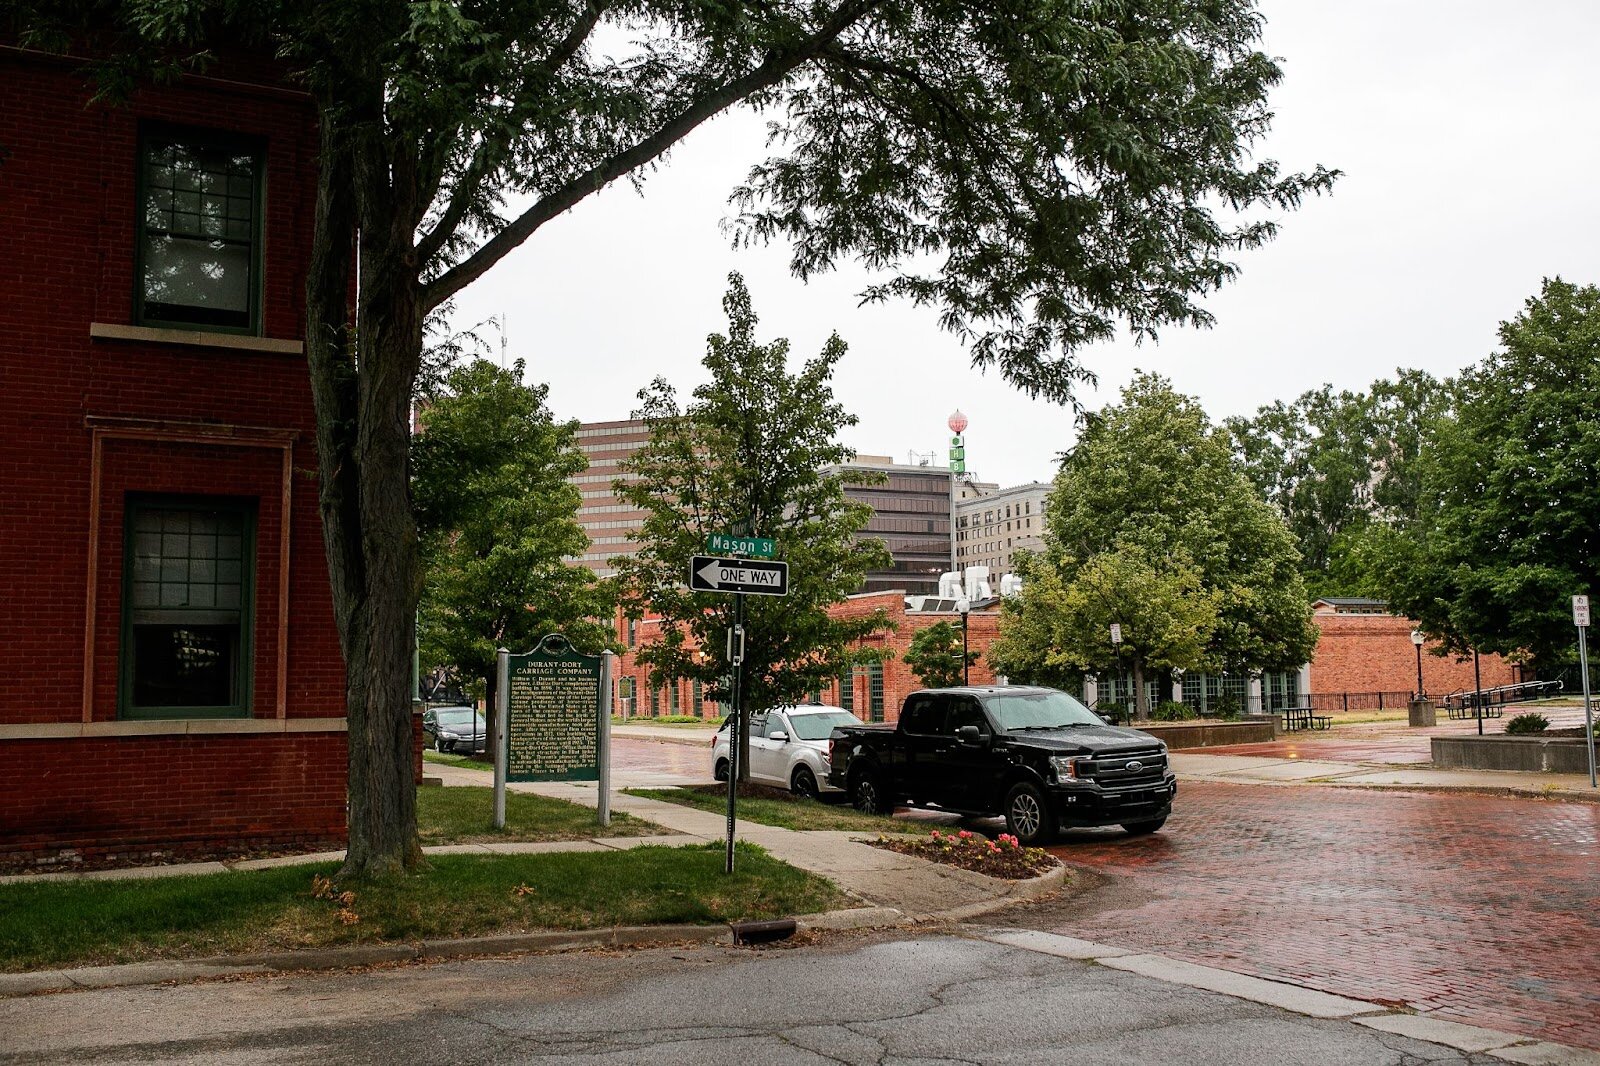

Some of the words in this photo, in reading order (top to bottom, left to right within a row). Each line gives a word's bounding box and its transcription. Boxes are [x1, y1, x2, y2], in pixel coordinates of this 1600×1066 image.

[712, 535, 755, 553] Mason
[762, 542, 772, 553] St
[720, 569, 746, 583] ONE
[750, 571, 777, 585] WAY
